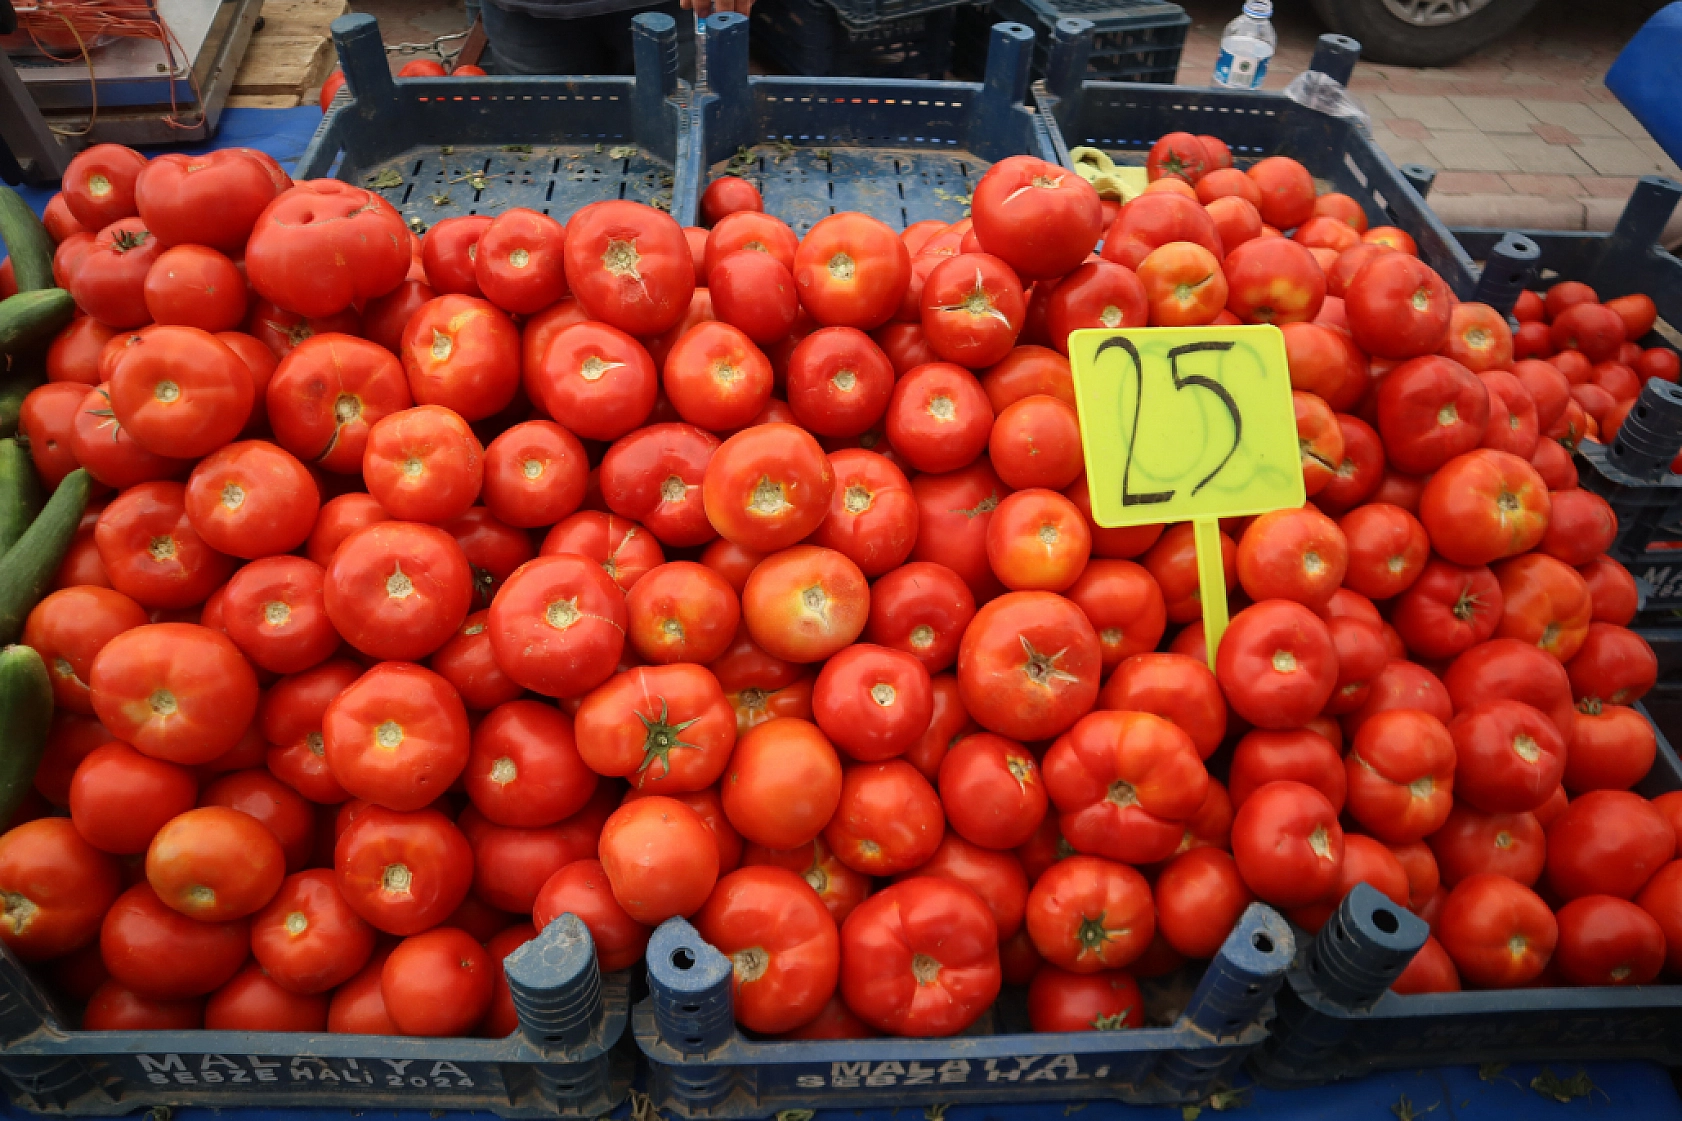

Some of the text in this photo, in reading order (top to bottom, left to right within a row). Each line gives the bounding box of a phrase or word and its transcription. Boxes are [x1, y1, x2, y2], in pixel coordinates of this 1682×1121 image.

[1093, 336, 1243, 507] 25
[148, 1068, 278, 1085] SEBZE
[385, 1074, 475, 1088] 2024
